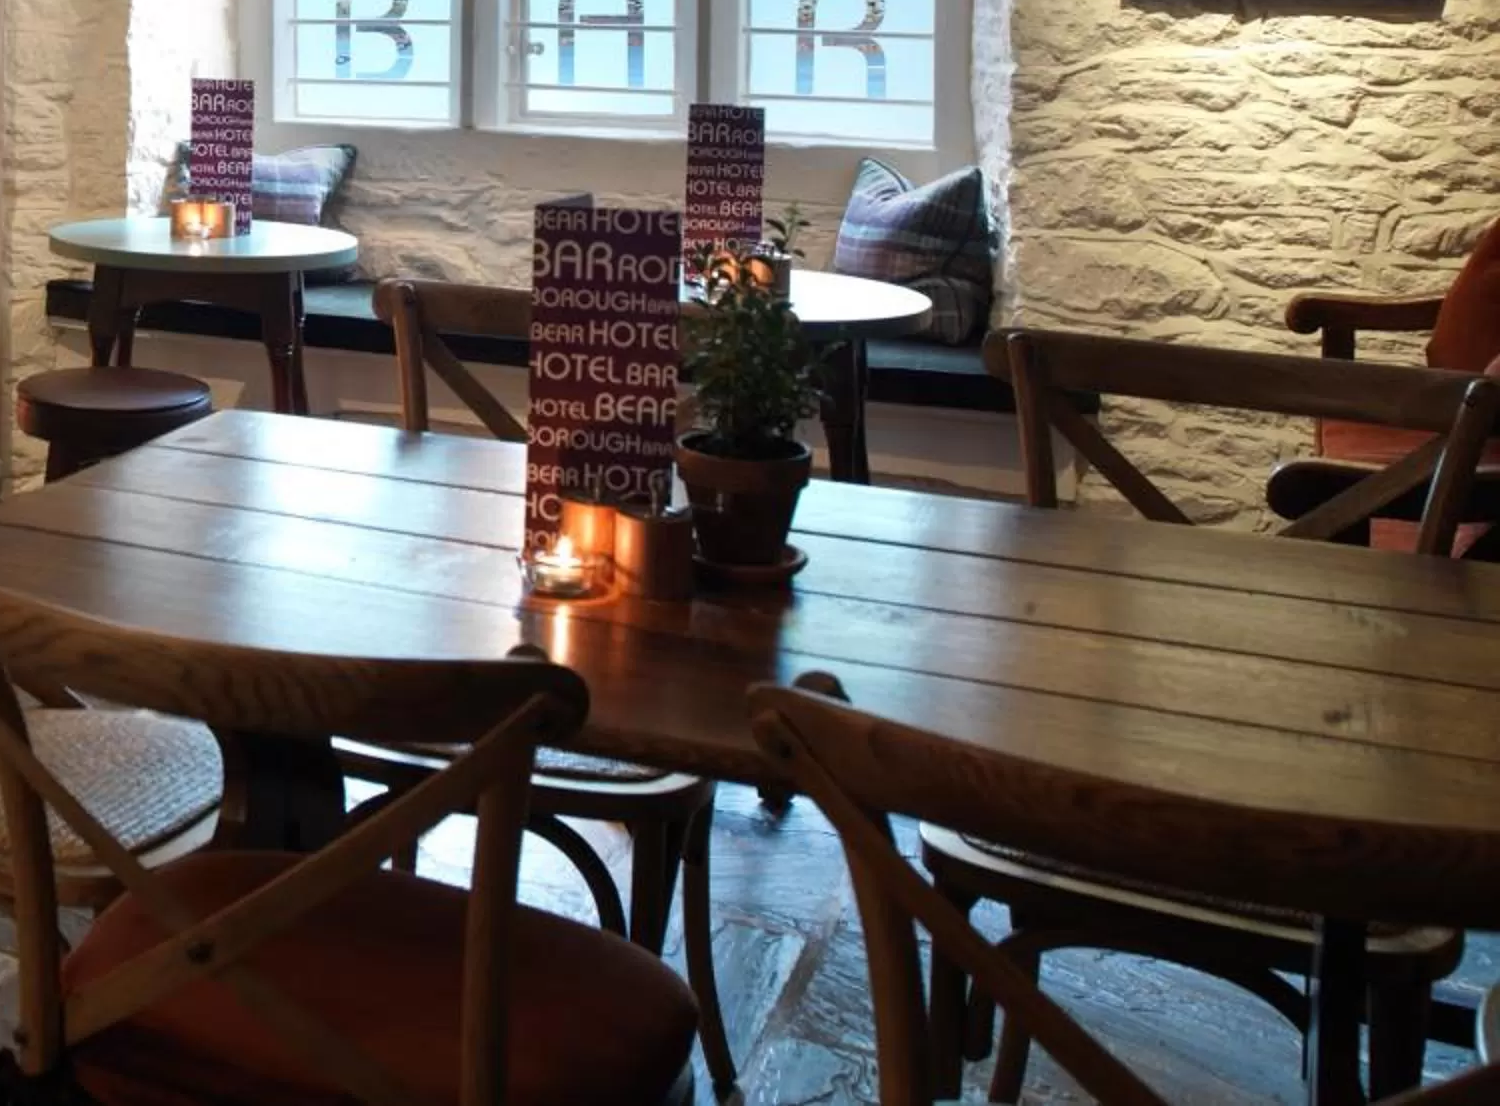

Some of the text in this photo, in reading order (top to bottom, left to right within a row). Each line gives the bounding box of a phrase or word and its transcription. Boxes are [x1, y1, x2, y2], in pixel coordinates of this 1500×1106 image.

[191, 93, 225, 112] BAR
[688, 121, 730, 143] BAR
[534, 208, 681, 236] BEAR HOTE
[532, 239, 613, 282] BAR
[531, 287, 646, 312] BOROUGH
[530, 320, 679, 351] BEAR HOTEL
[529, 351, 679, 388] HOTEL BAR
[529, 398, 591, 421] HOTEL
[527, 425, 641, 455] BOROUGH
[527, 463, 580, 488] BEAR
